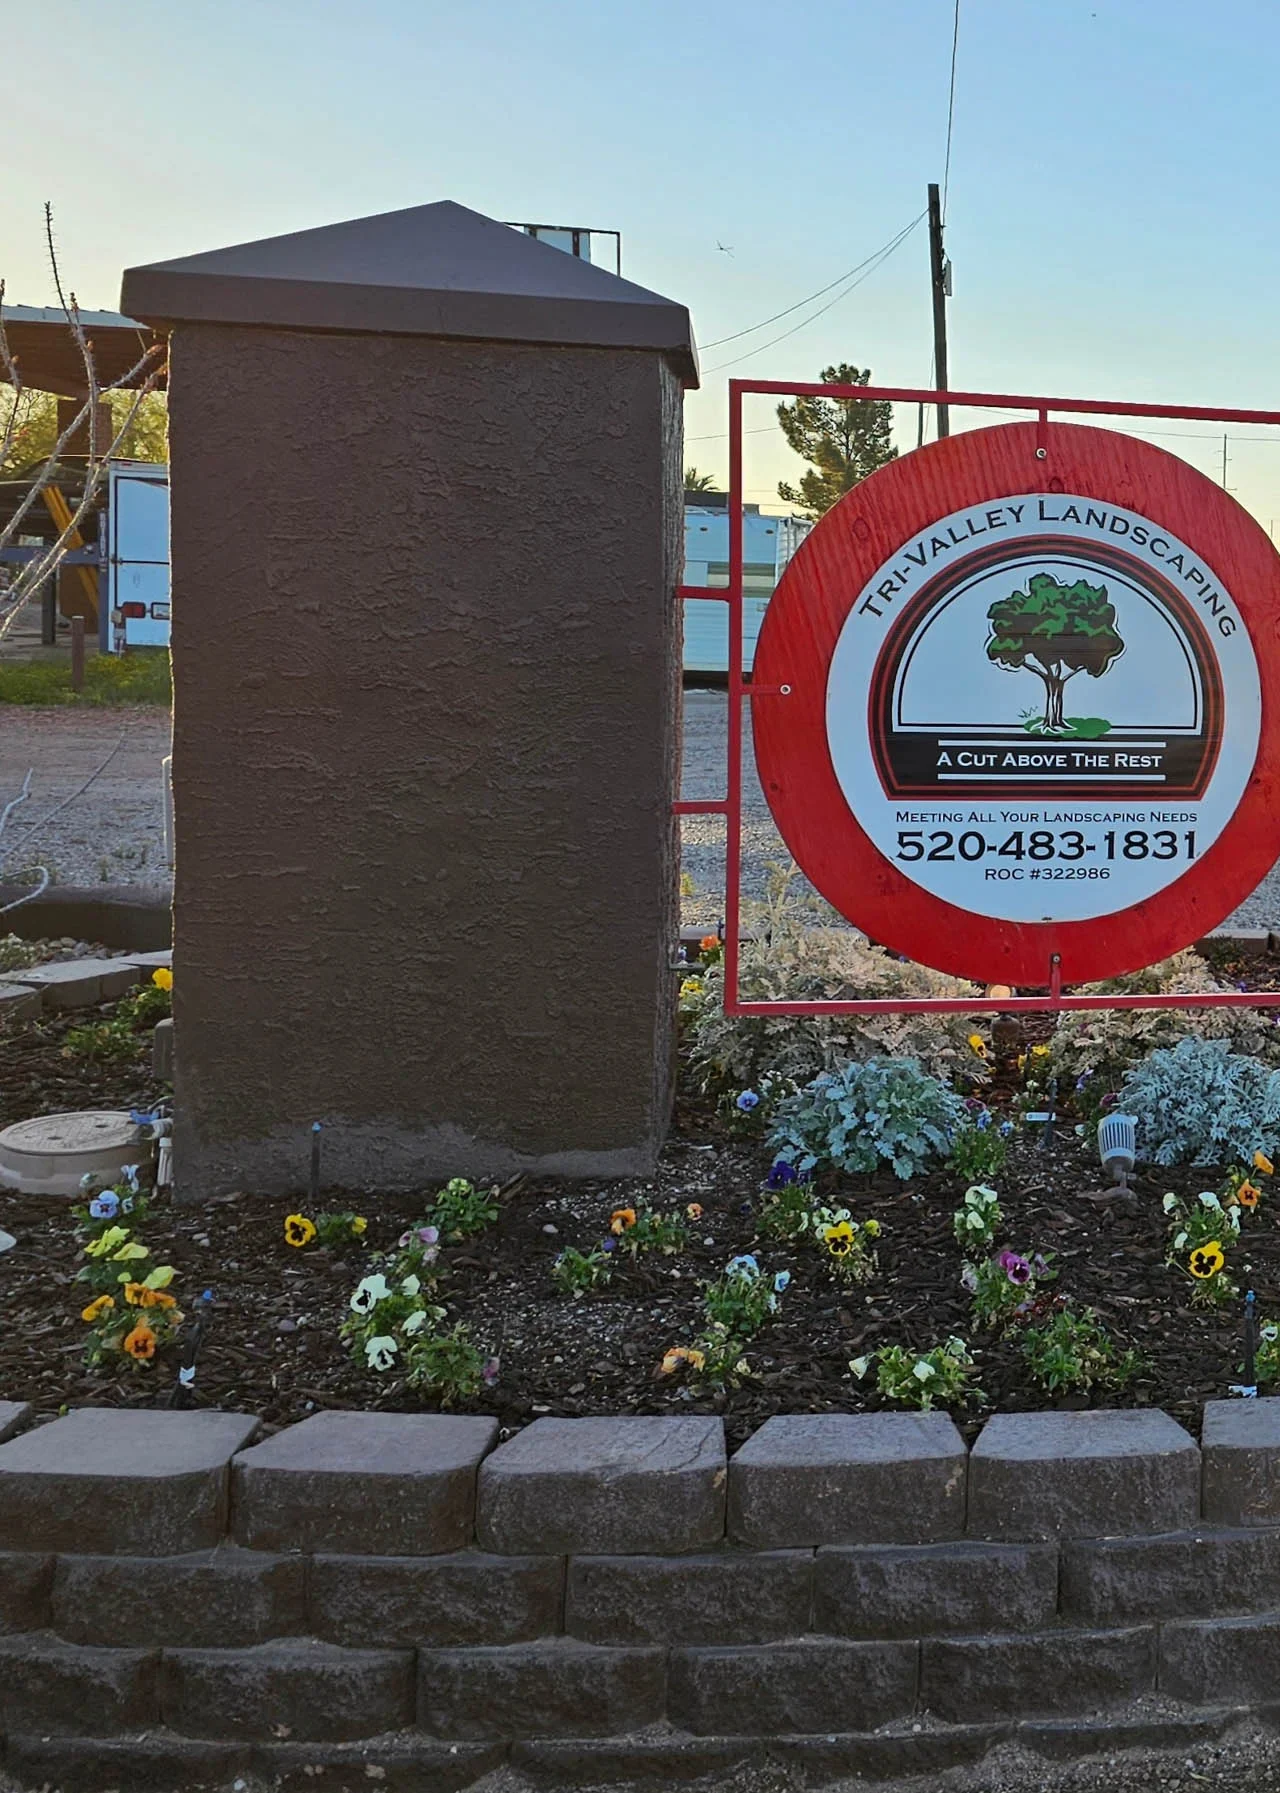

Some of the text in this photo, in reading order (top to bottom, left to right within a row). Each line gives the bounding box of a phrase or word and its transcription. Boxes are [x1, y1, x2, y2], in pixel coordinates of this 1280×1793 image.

[858, 499, 1236, 638] TRI-VALLEY LANDSCAPING
[936, 752, 1163, 768] A CUT ABOVE THE REST
[896, 811, 1198, 823] MEETING ALL YOUR LANDSCAPING NEEDS
[896, 830, 1197, 862] 520-483-1831
[984, 867, 1111, 881] ROC #322986
